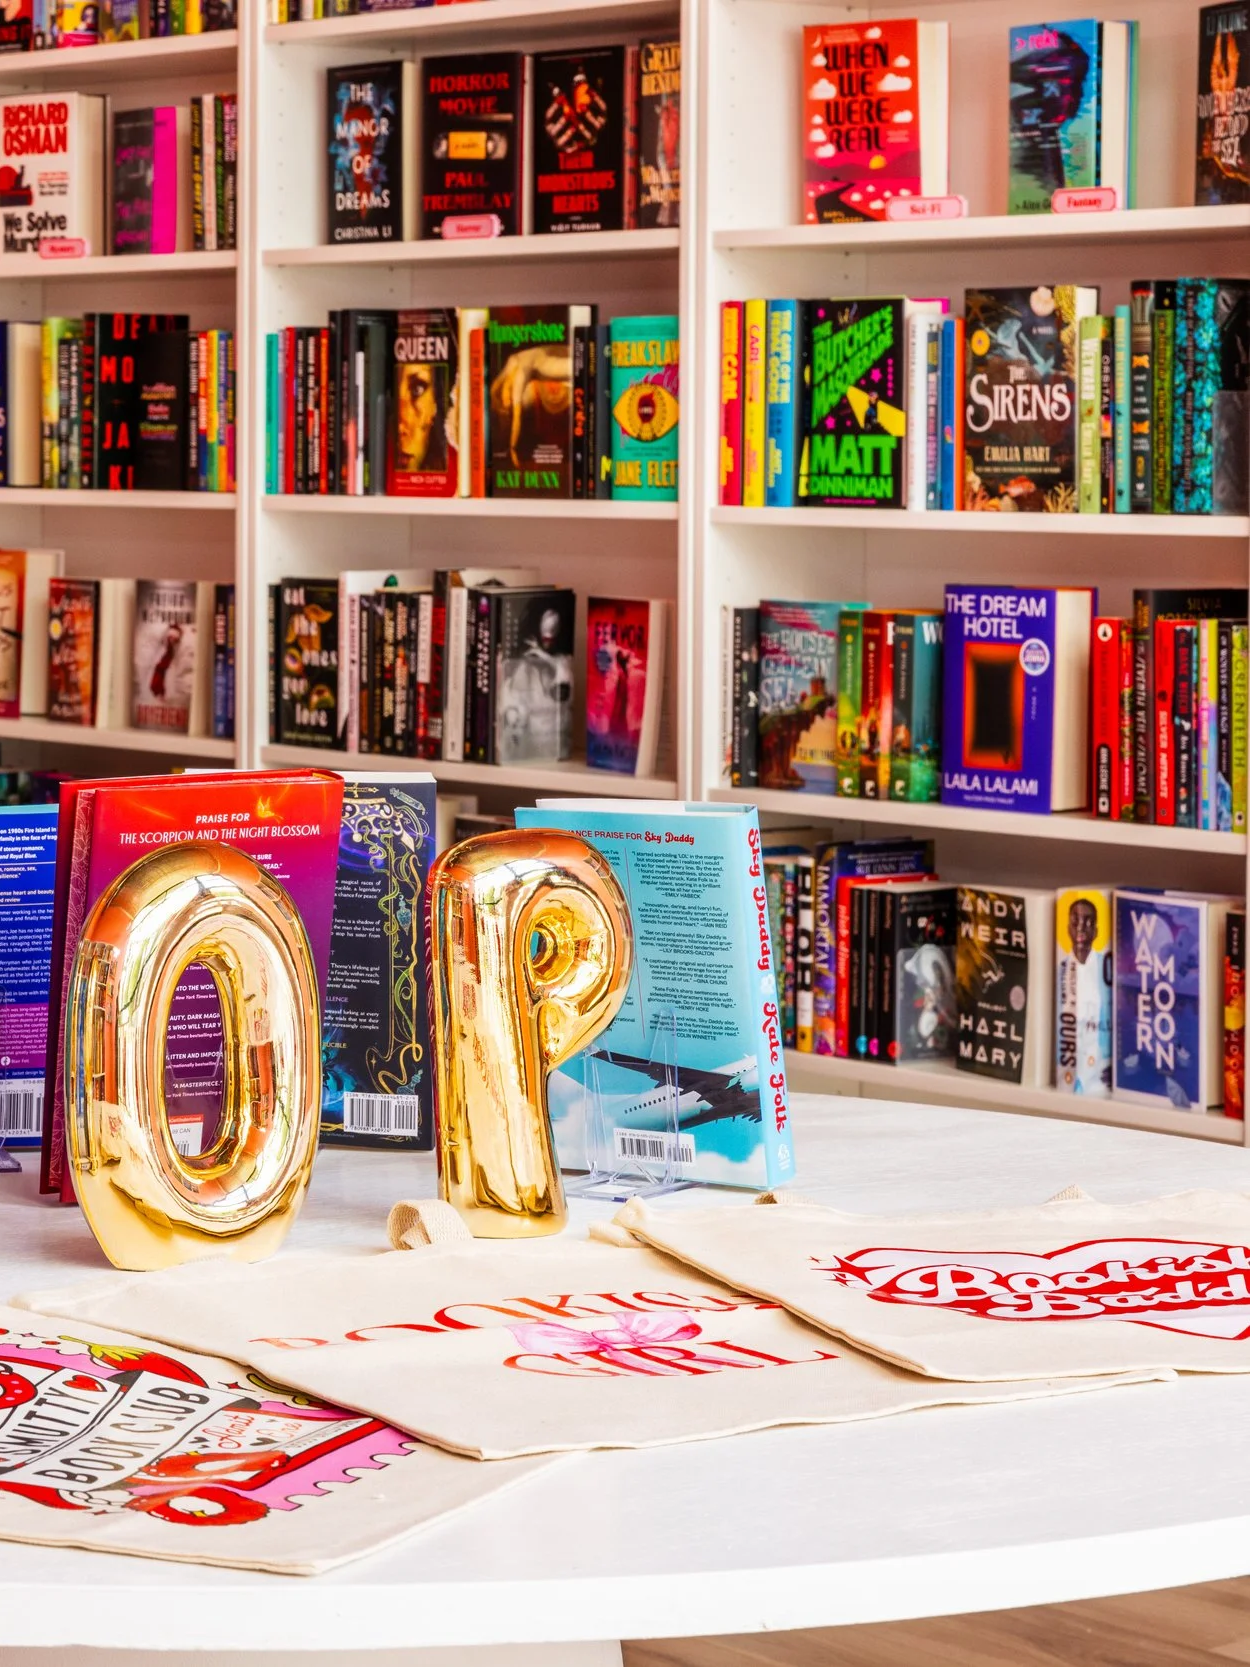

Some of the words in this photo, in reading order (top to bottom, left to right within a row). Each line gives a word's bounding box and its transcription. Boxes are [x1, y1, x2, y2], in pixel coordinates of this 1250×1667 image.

[822, 42, 889, 72] WHEN
[350, 83, 374, 103] THE
[430, 73, 509, 95] HORROR
[837, 71, 874, 98] WE
[3, 102, 68, 128] RICHARD
[439, 96, 498, 116] MOVIE
[825, 97, 890, 126] WERE
[4, 126, 68, 156] OSMAN
[336, 117, 390, 140] MANOR
[830, 124, 886, 153] REAL
[352, 155, 372, 174] OF
[445, 172, 487, 189] PAUL
[336, 189, 391, 211] DREAMS
[423, 192, 513, 213] TREMBLAY
[908, 202, 943, 216] Sci-Fi
[1066, 195, 1103, 209] Fantasy
[3, 213, 23, 231] We
[26, 211, 68, 232] Solve
[334, 226, 379, 240] CHRISTINA
[489, 319, 566, 347] Hungerstone
[812, 304, 894, 386] BUTCHER'S
[394, 336, 450, 363] QUEEN
[1007, 364, 1028, 384] THE
[1080, 337, 1099, 402] WEYWARD
[966, 373, 1072, 434] SIRENS
[811, 432, 898, 475] MATT
[984, 446, 1022, 463] EMILIA
[1023, 446, 1052, 463] HART
[496, 470, 521, 489] KAT
[524, 470, 560, 489] DUNN
[613, 458, 642, 489] JANE
[809, 475, 894, 499] DINNIMAN
[945, 593, 977, 615] THE
[980, 595, 1047, 618] DREAM
[963, 616, 1024, 640] HOTEL
[302, 650, 338, 668] ones
[295, 702, 329, 728] love
[944, 772, 982, 792] LAILA
[984, 775, 1039, 797] LALAMI
[195, 813, 227, 824] PRAISE
[230, 812, 250, 823] FOR
[119, 832, 138, 845] THE
[139, 829, 194, 844] SCORPION
[196, 829, 219, 841] AND
[221, 828, 237, 840] THE
[238, 826, 269, 839] NIGHT
[271, 824, 320, 838] BLOSSOM
[594, 831, 624, 840] PRAISE
[625, 832, 643, 841] FOR
[644, 831, 662, 844] Sky
[664, 832, 695, 846] Daddy
[747, 827, 761, 878] Sky
[815, 864, 831, 971] IMMORTAL
[960, 892, 1025, 920] ANDY
[752, 886, 772, 972] Daddy
[960, 922, 1026, 950] WEIR
[1131, 908, 1159, 1055] WATER
[1153, 950, 1177, 1072] MOON
[172, 1023, 186, 1031] WHO
[202, 1022, 216, 1030] TEAR
[692, 1033, 717, 1041] WINNETTE
[762, 1002, 780, 1068] Kate
[959, 1012, 1024, 1043] HAIL
[1060, 1011, 1078, 1070] OURS
[959, 1039, 1022, 1070] MARY
[769, 1072, 788, 1136] Folk
[502, 1339, 841, 1378] GIRL
[33, 1431, 160, 1485] BOOK
[110, 1386, 210, 1434] CLUB
